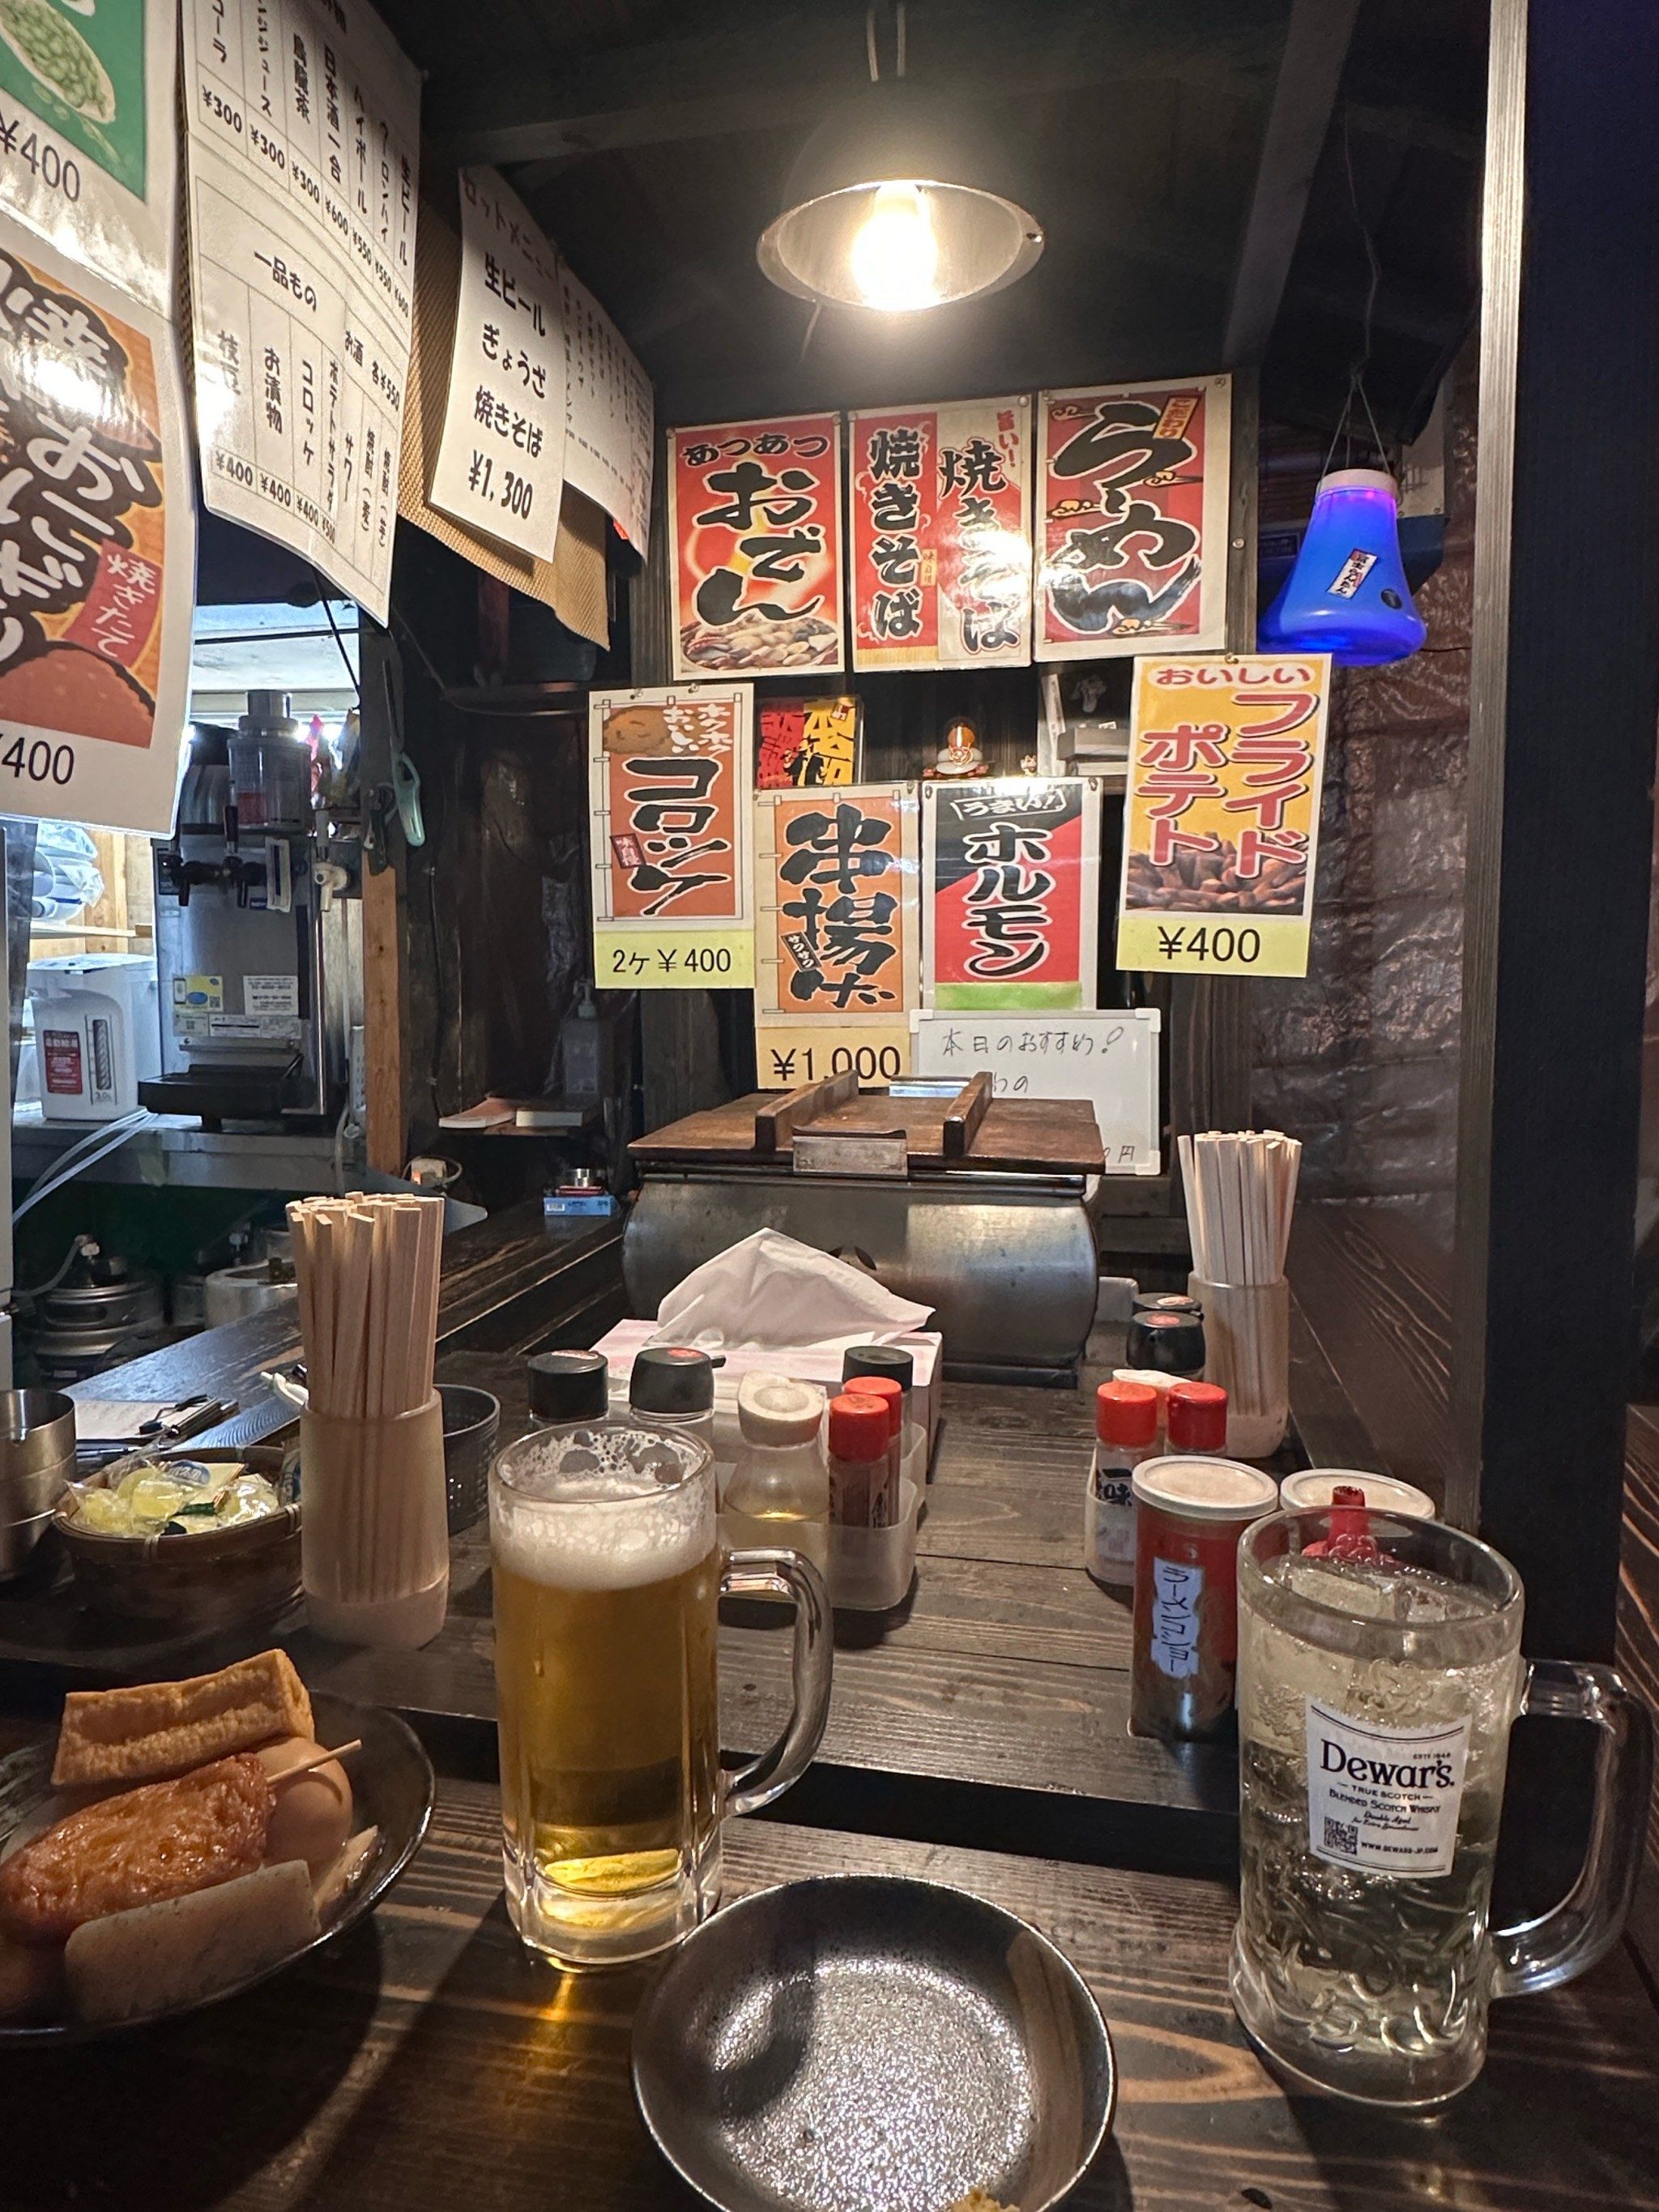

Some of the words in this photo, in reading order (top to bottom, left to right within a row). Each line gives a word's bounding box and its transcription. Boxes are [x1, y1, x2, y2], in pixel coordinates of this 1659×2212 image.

[203, 84, 242, 133] ¥300
[324, 44, 341, 184] 日本酒一合
[0, 109, 80, 202] ¥400
[250, 123, 285, 169] ¥300
[292, 160, 320, 203] ¥300
[353, 85, 367, 216] ハイボール
[325, 195, 348, 236] ¥600
[352, 227, 372, 266] ¥550
[254, 250, 318, 313] 一品もの
[484, 250, 546, 337] 生ビール
[264, 346, 283, 435] お漬物
[344, 329, 364, 368] お酒
[372, 360, 400, 412] 各¥550
[481, 322, 546, 399] ぎょうざ
[301, 359, 315, 466] コロッケ
[475, 385, 544, 459] 焼きそば
[215, 449, 254, 486] ¥400
[468, 449, 534, 520] ¥1,300
[684, 433, 830, 466] あつあつ
[259, 472, 292, 507] ¥400
[296, 493, 319, 527] ¥400
[697, 461, 825, 627] おでん
[868, 428, 923, 638] 焼きそば
[92, 552, 158, 659] 焼きたて
[1156, 667, 1312, 686] おいしい
[0, 736, 75, 785] 400
[697, 702, 733, 758] ホクホク
[1136, 723, 1230, 867] ポテト
[1224, 690, 1322, 880] フライド
[622, 757, 732, 917] コロッケ
[778, 802, 899, 1010] 串揚げ
[962, 822, 1056, 979] ホルモン
[1158, 925, 1261, 963] ¥400
[770, 1045, 902, 1082] ¥1,000
[942, 1026, 1124, 1057] 本日のおすすめ!
[1352, 1785, 1378, 1796] TRUE
[1380, 1791, 1421, 1800] SCOTCH
